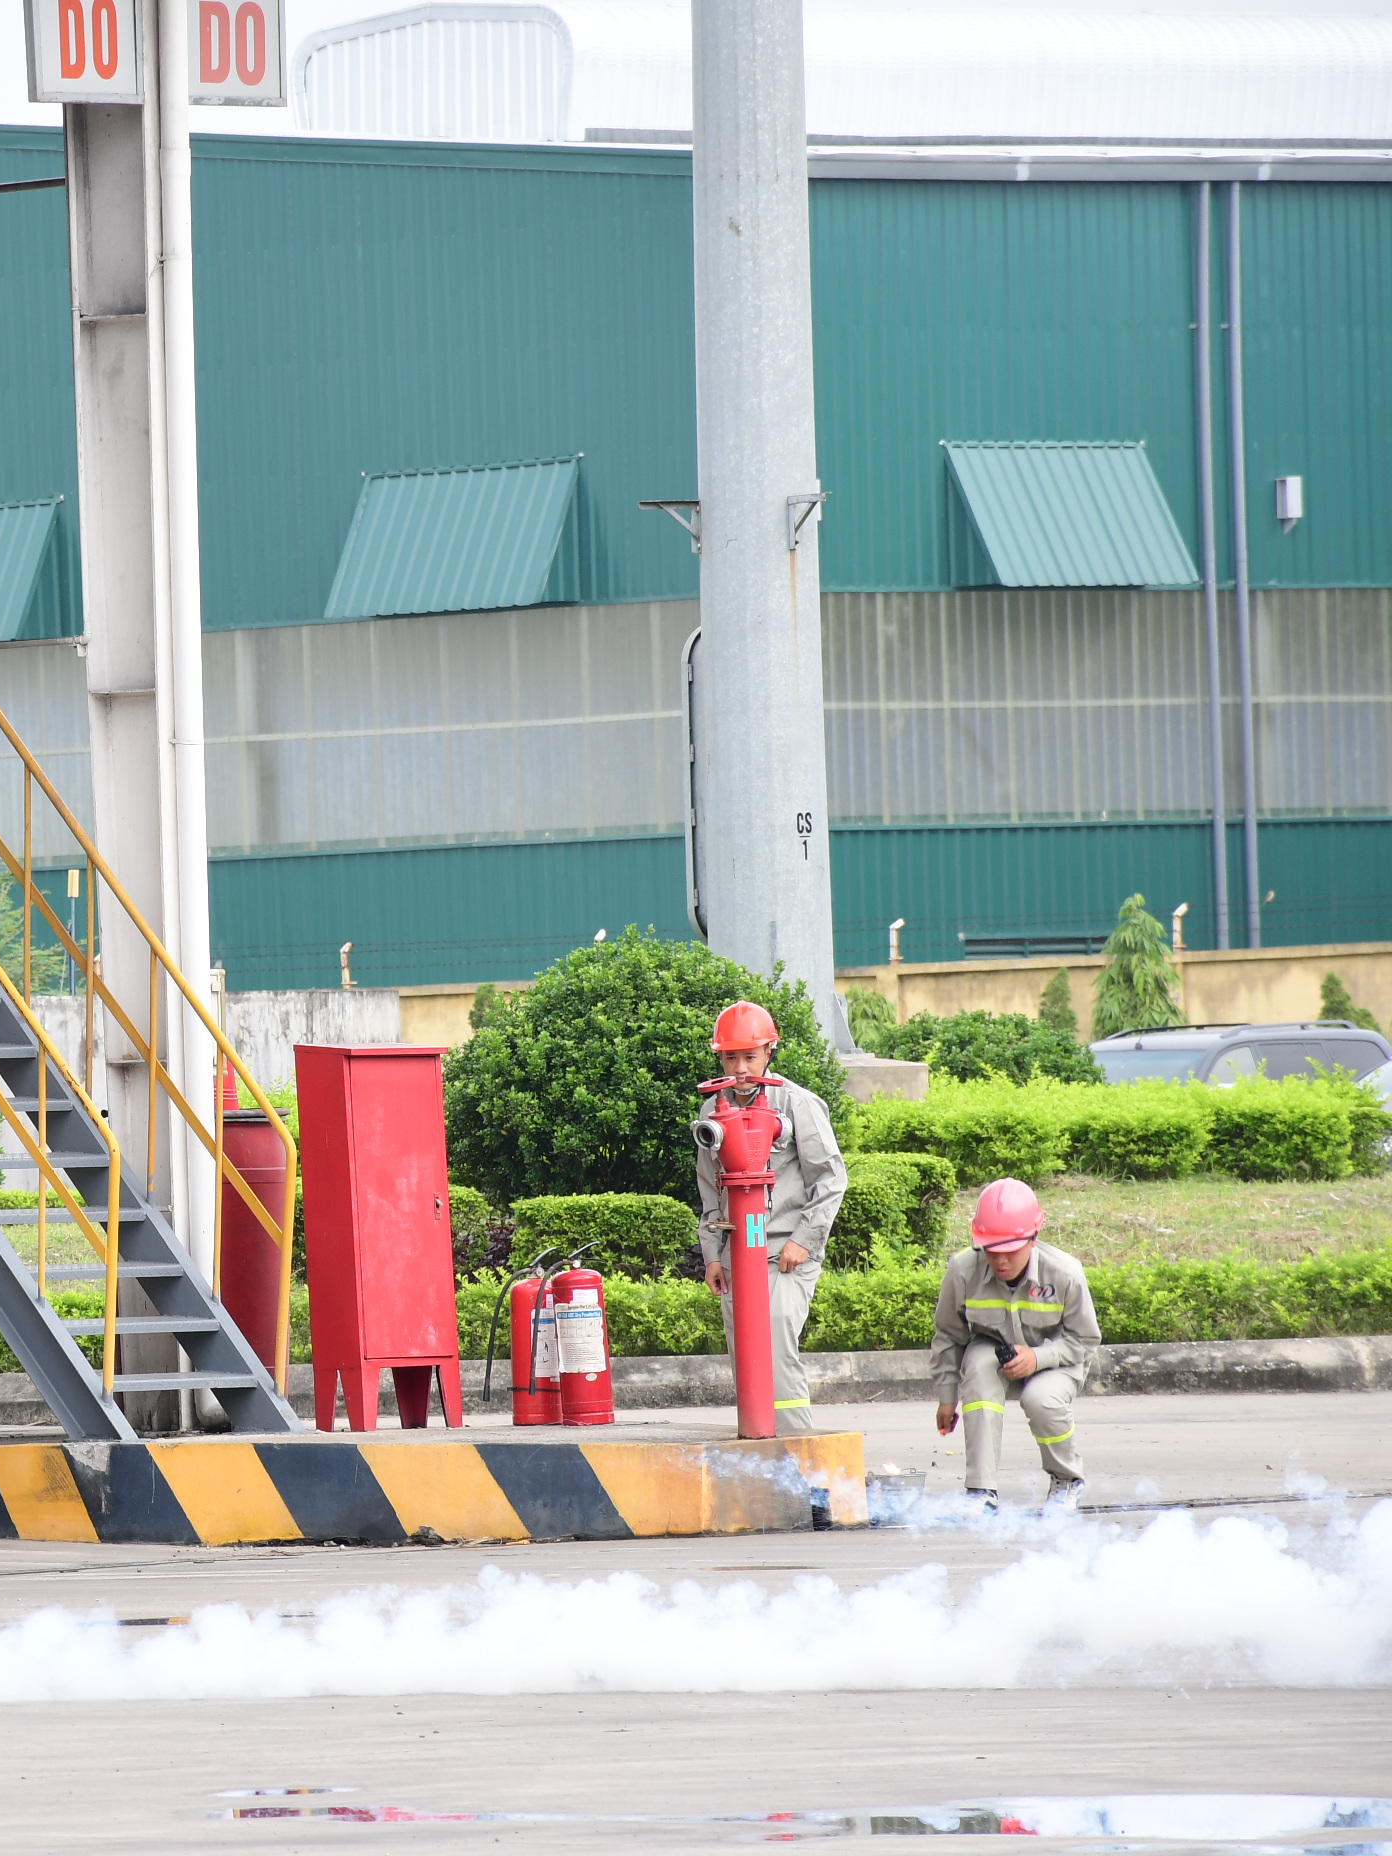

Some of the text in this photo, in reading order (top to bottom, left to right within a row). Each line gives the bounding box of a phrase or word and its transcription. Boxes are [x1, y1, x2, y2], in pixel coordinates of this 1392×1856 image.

[59, 0, 118, 80] DO
[199, 1, 266, 86] DO
[797, 812, 812, 834] CS
[802, 840, 808, 860] 1
[746, 1213, 767, 1247] H
